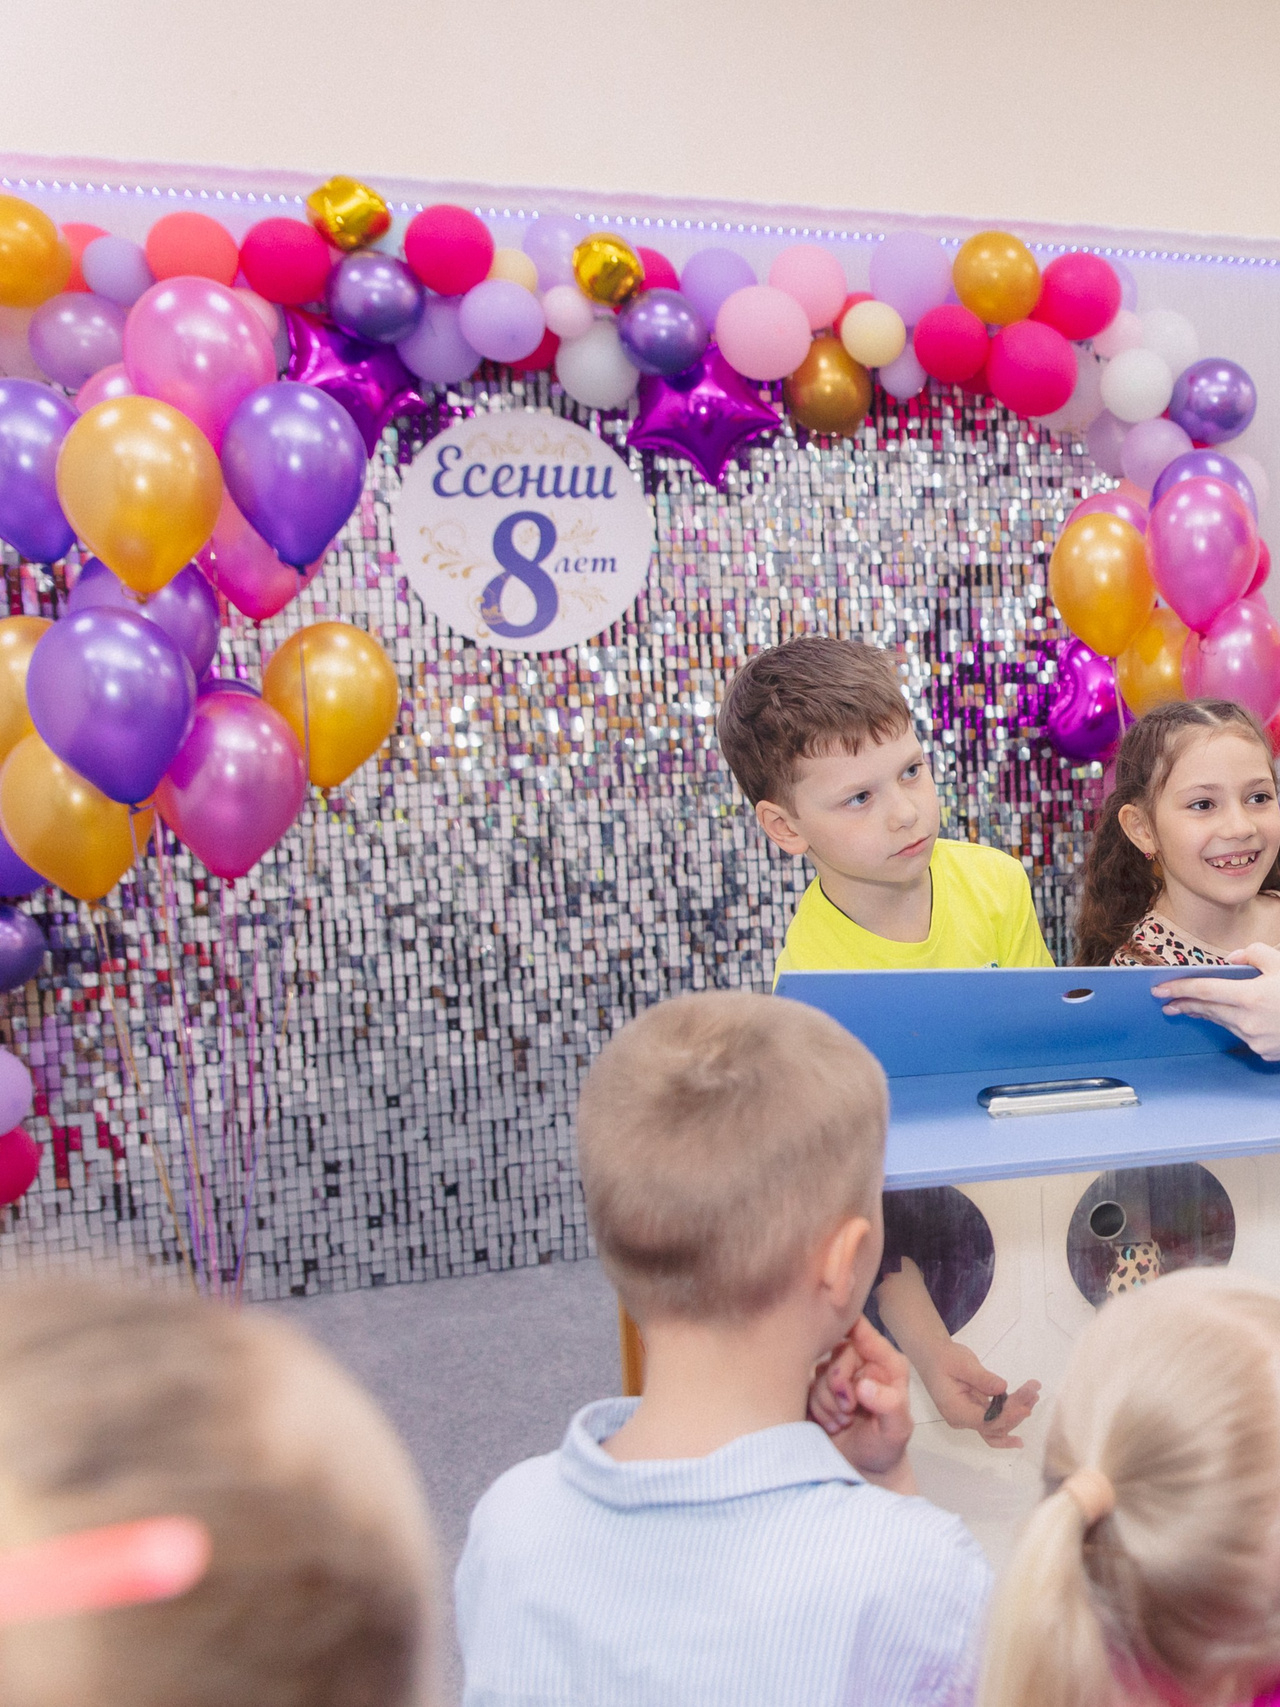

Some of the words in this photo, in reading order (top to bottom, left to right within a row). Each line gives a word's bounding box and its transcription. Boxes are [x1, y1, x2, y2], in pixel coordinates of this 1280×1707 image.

[431, 444, 617, 499] Есении
[480, 510, 559, 639] 8
[554, 556, 618, 574] лет
